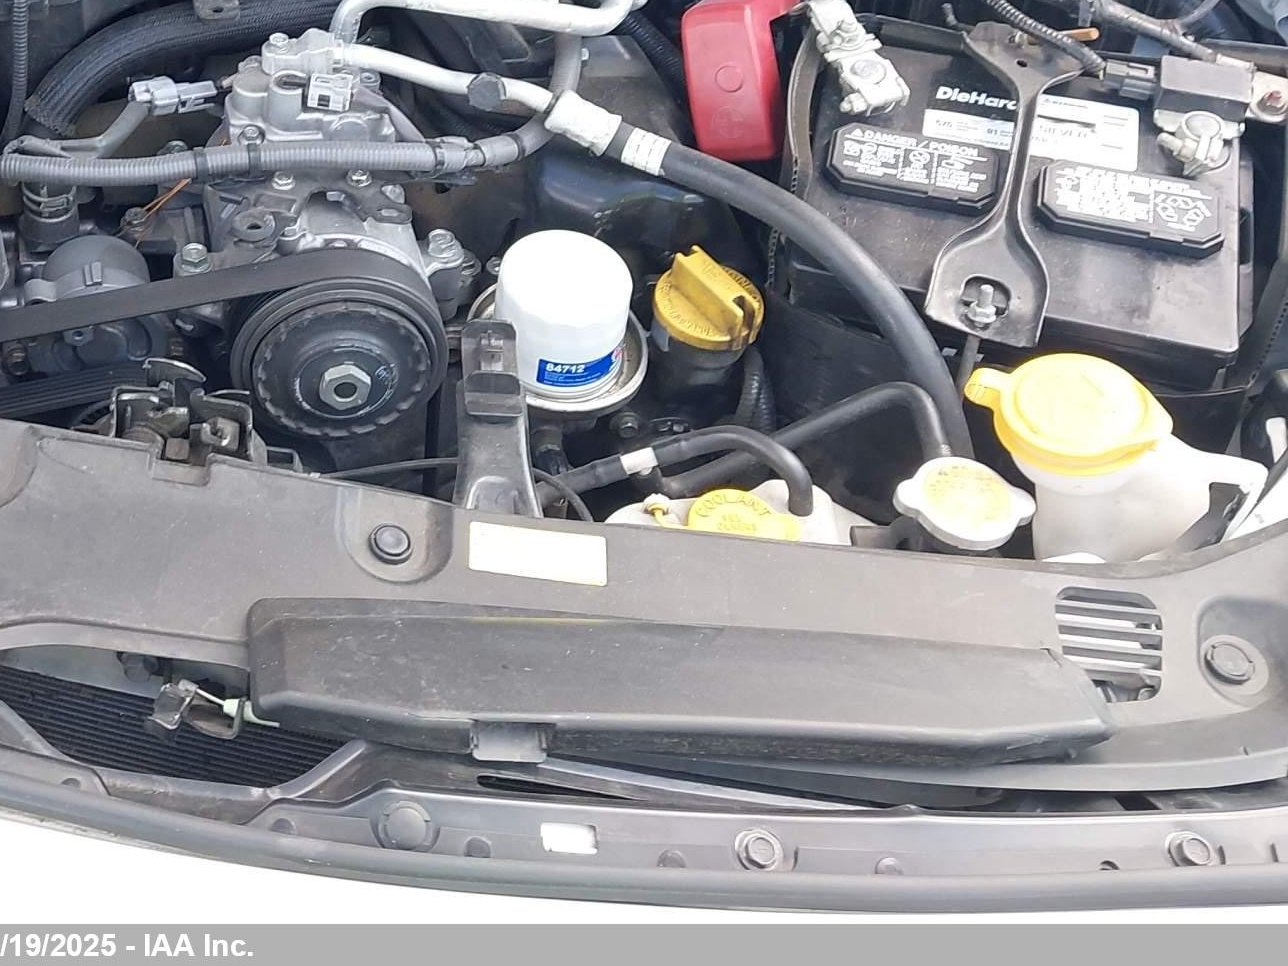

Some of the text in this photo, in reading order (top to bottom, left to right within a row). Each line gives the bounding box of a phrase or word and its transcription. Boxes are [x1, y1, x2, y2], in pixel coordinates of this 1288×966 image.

[863, 130, 917, 147] DANGER
[929, 141, 979, 156] POISON
[545, 362, 585, 373] 84712
[695, 493, 772, 517] COOLANT
